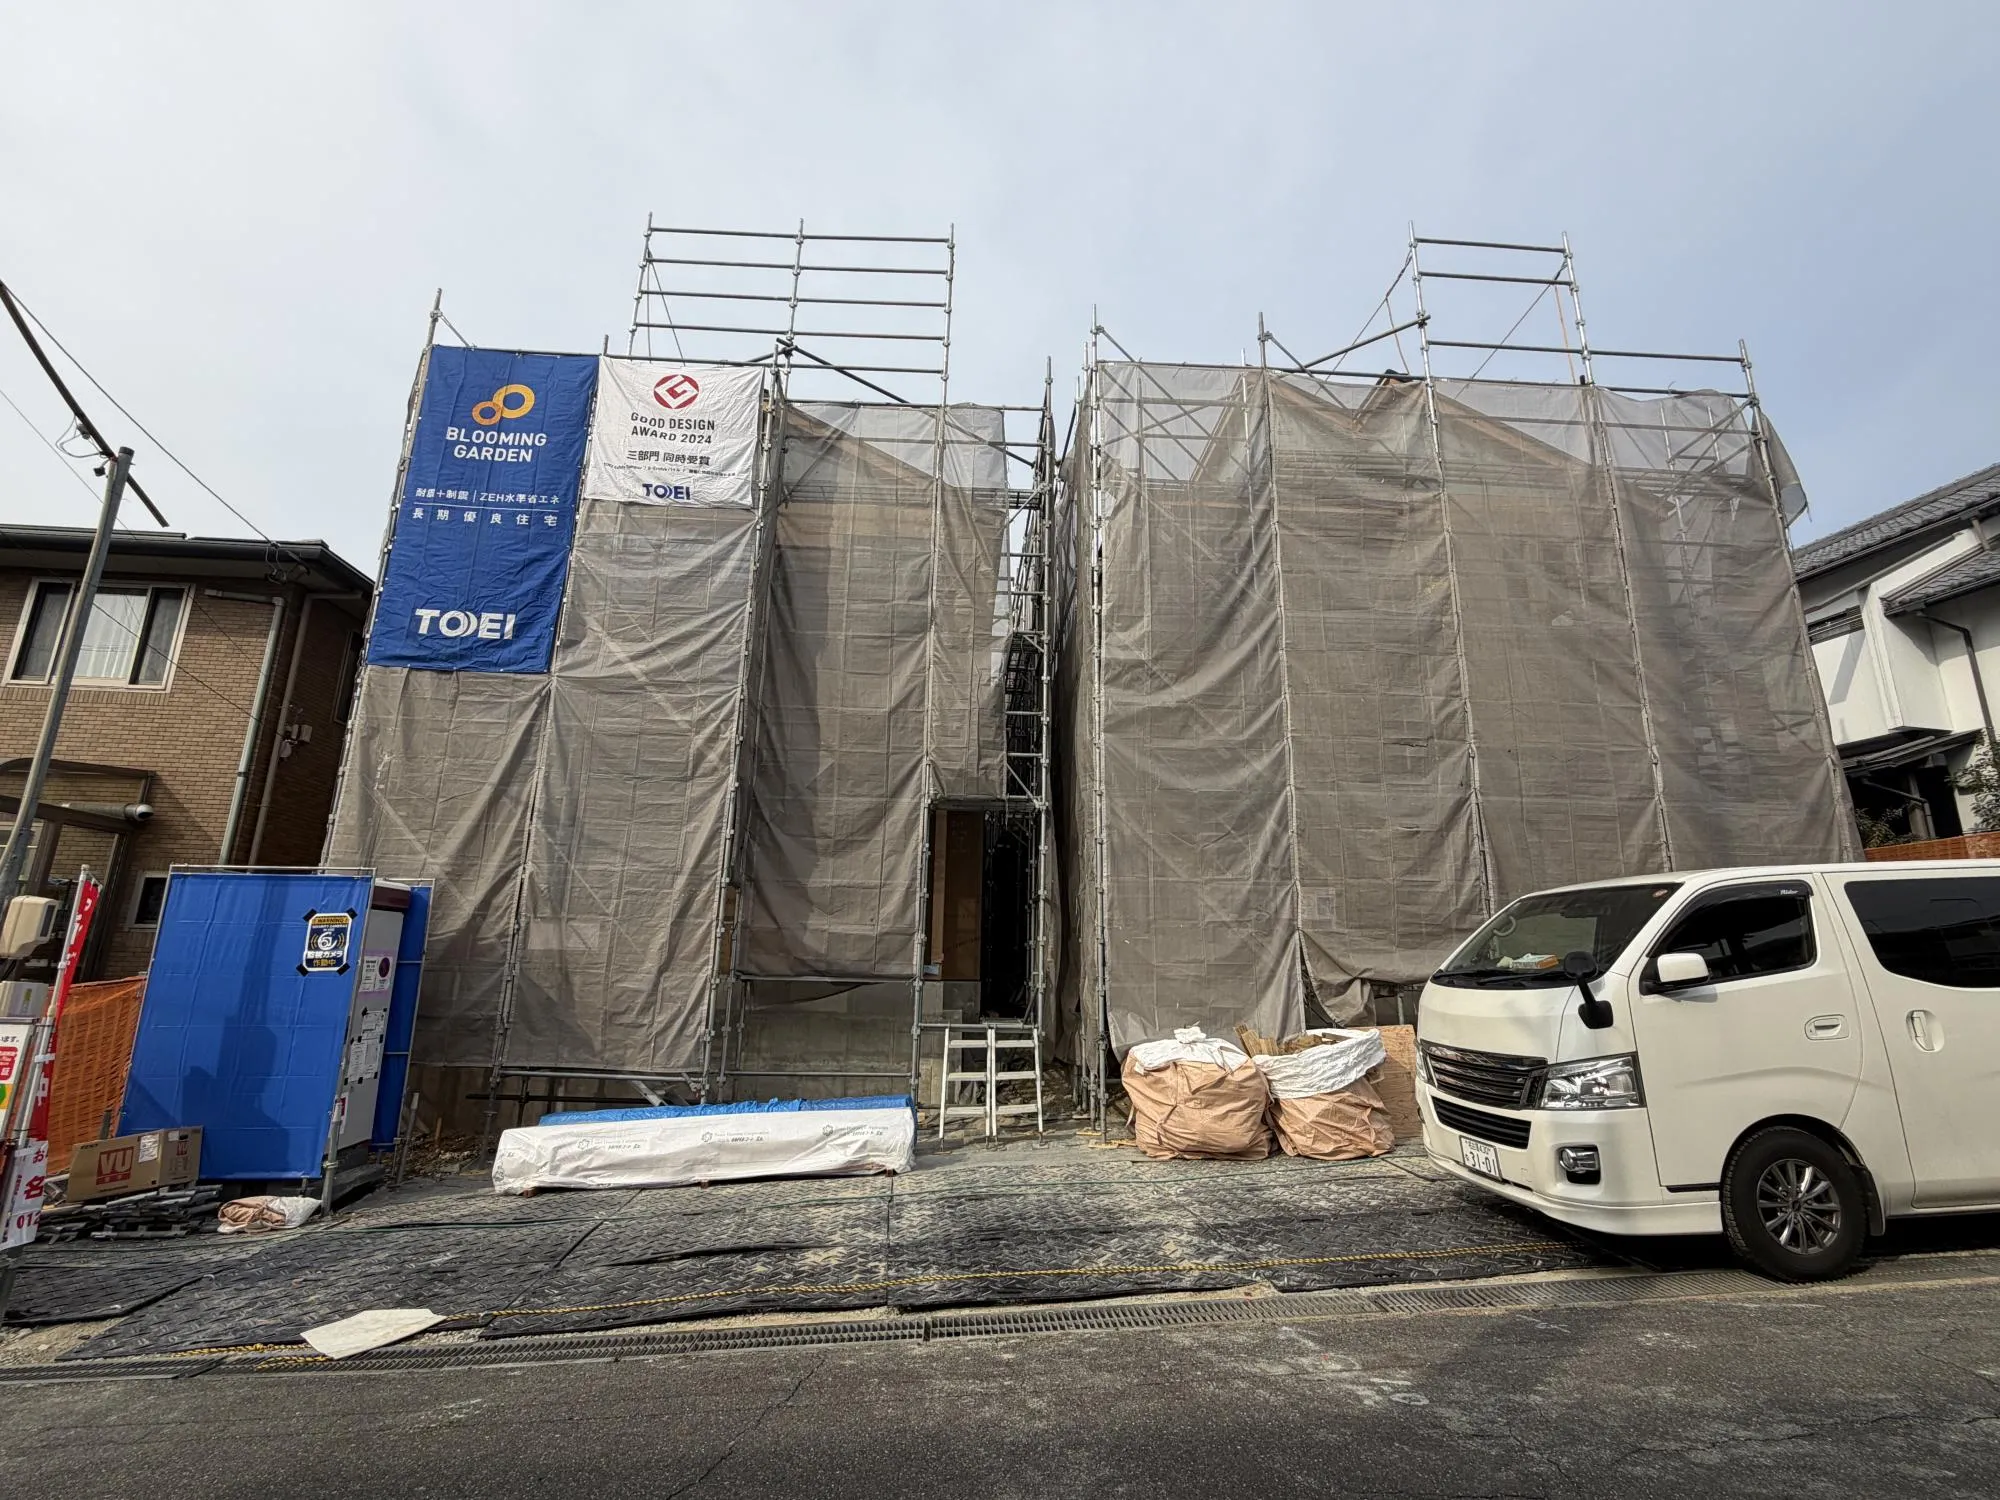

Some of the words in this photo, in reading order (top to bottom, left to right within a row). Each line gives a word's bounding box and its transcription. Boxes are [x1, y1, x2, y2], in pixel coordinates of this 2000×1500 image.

[631, 412, 665, 429] GOOD
[669, 418, 716, 431] DESIGN
[446, 426, 548, 447] BLOOMING
[631, 425, 677, 441] AWARD
[680, 433, 712, 445] 2024
[453, 444, 533, 463] GARDEN
[627, 450, 660, 462] 三部門
[663, 452, 711, 467] 同時受賞
[412, 507, 558, 527] 長期優良住宅
[100, 1148, 133, 1175] VU
